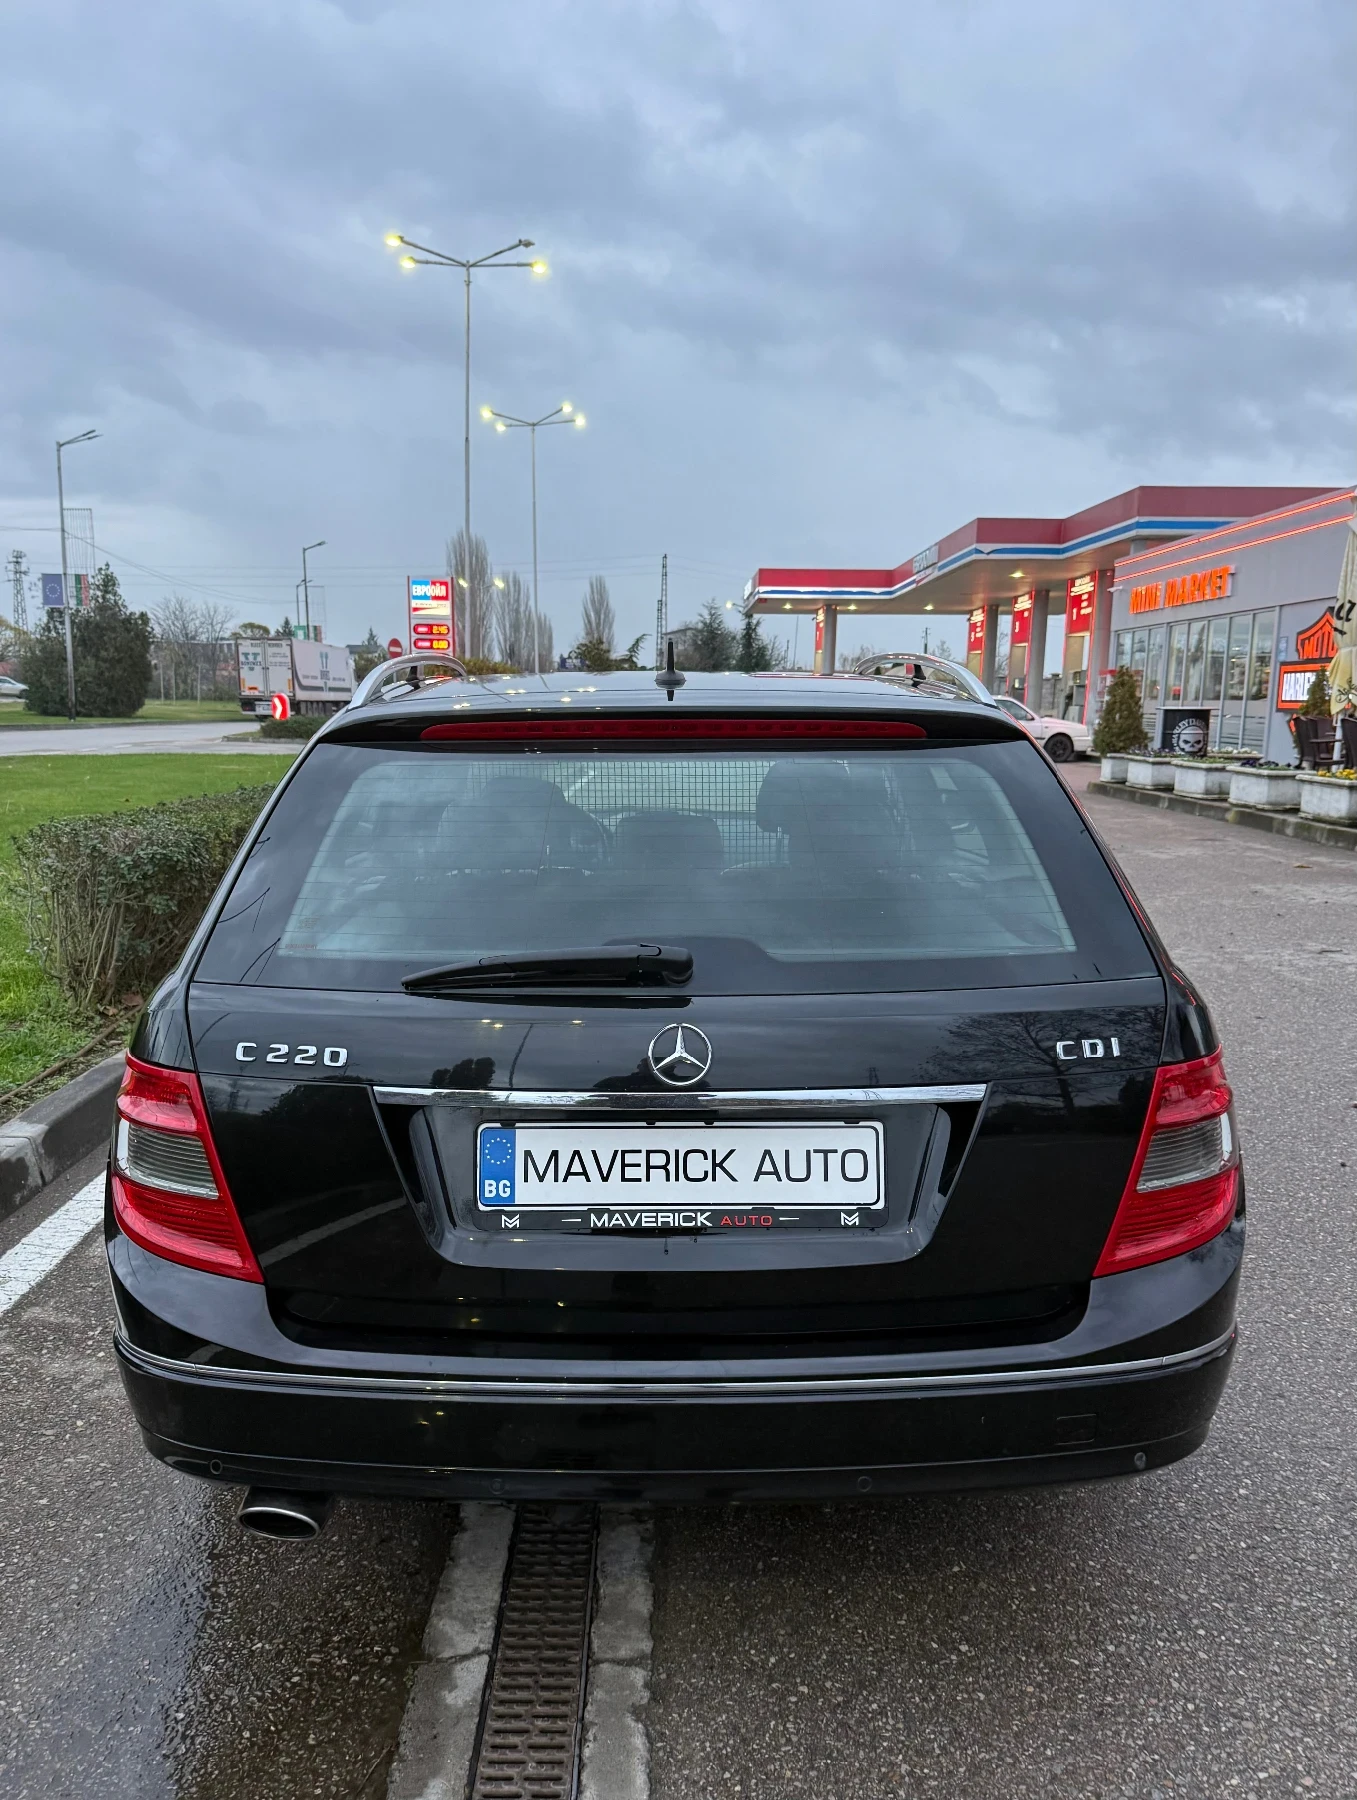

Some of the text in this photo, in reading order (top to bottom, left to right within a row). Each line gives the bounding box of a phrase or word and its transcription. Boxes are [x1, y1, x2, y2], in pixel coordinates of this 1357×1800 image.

[1129, 581, 1162, 614] MINI
[1164, 565, 1234, 607] MARKET
[235, 1041, 348, 1068] C 220
[1055, 1036, 1120, 1061] CDI
[523, 1148, 870, 1183] MAVERICK AUTO
[484, 1179, 512, 1199] BG
[590, 1211, 773, 1227] MAVERICK AUTO
